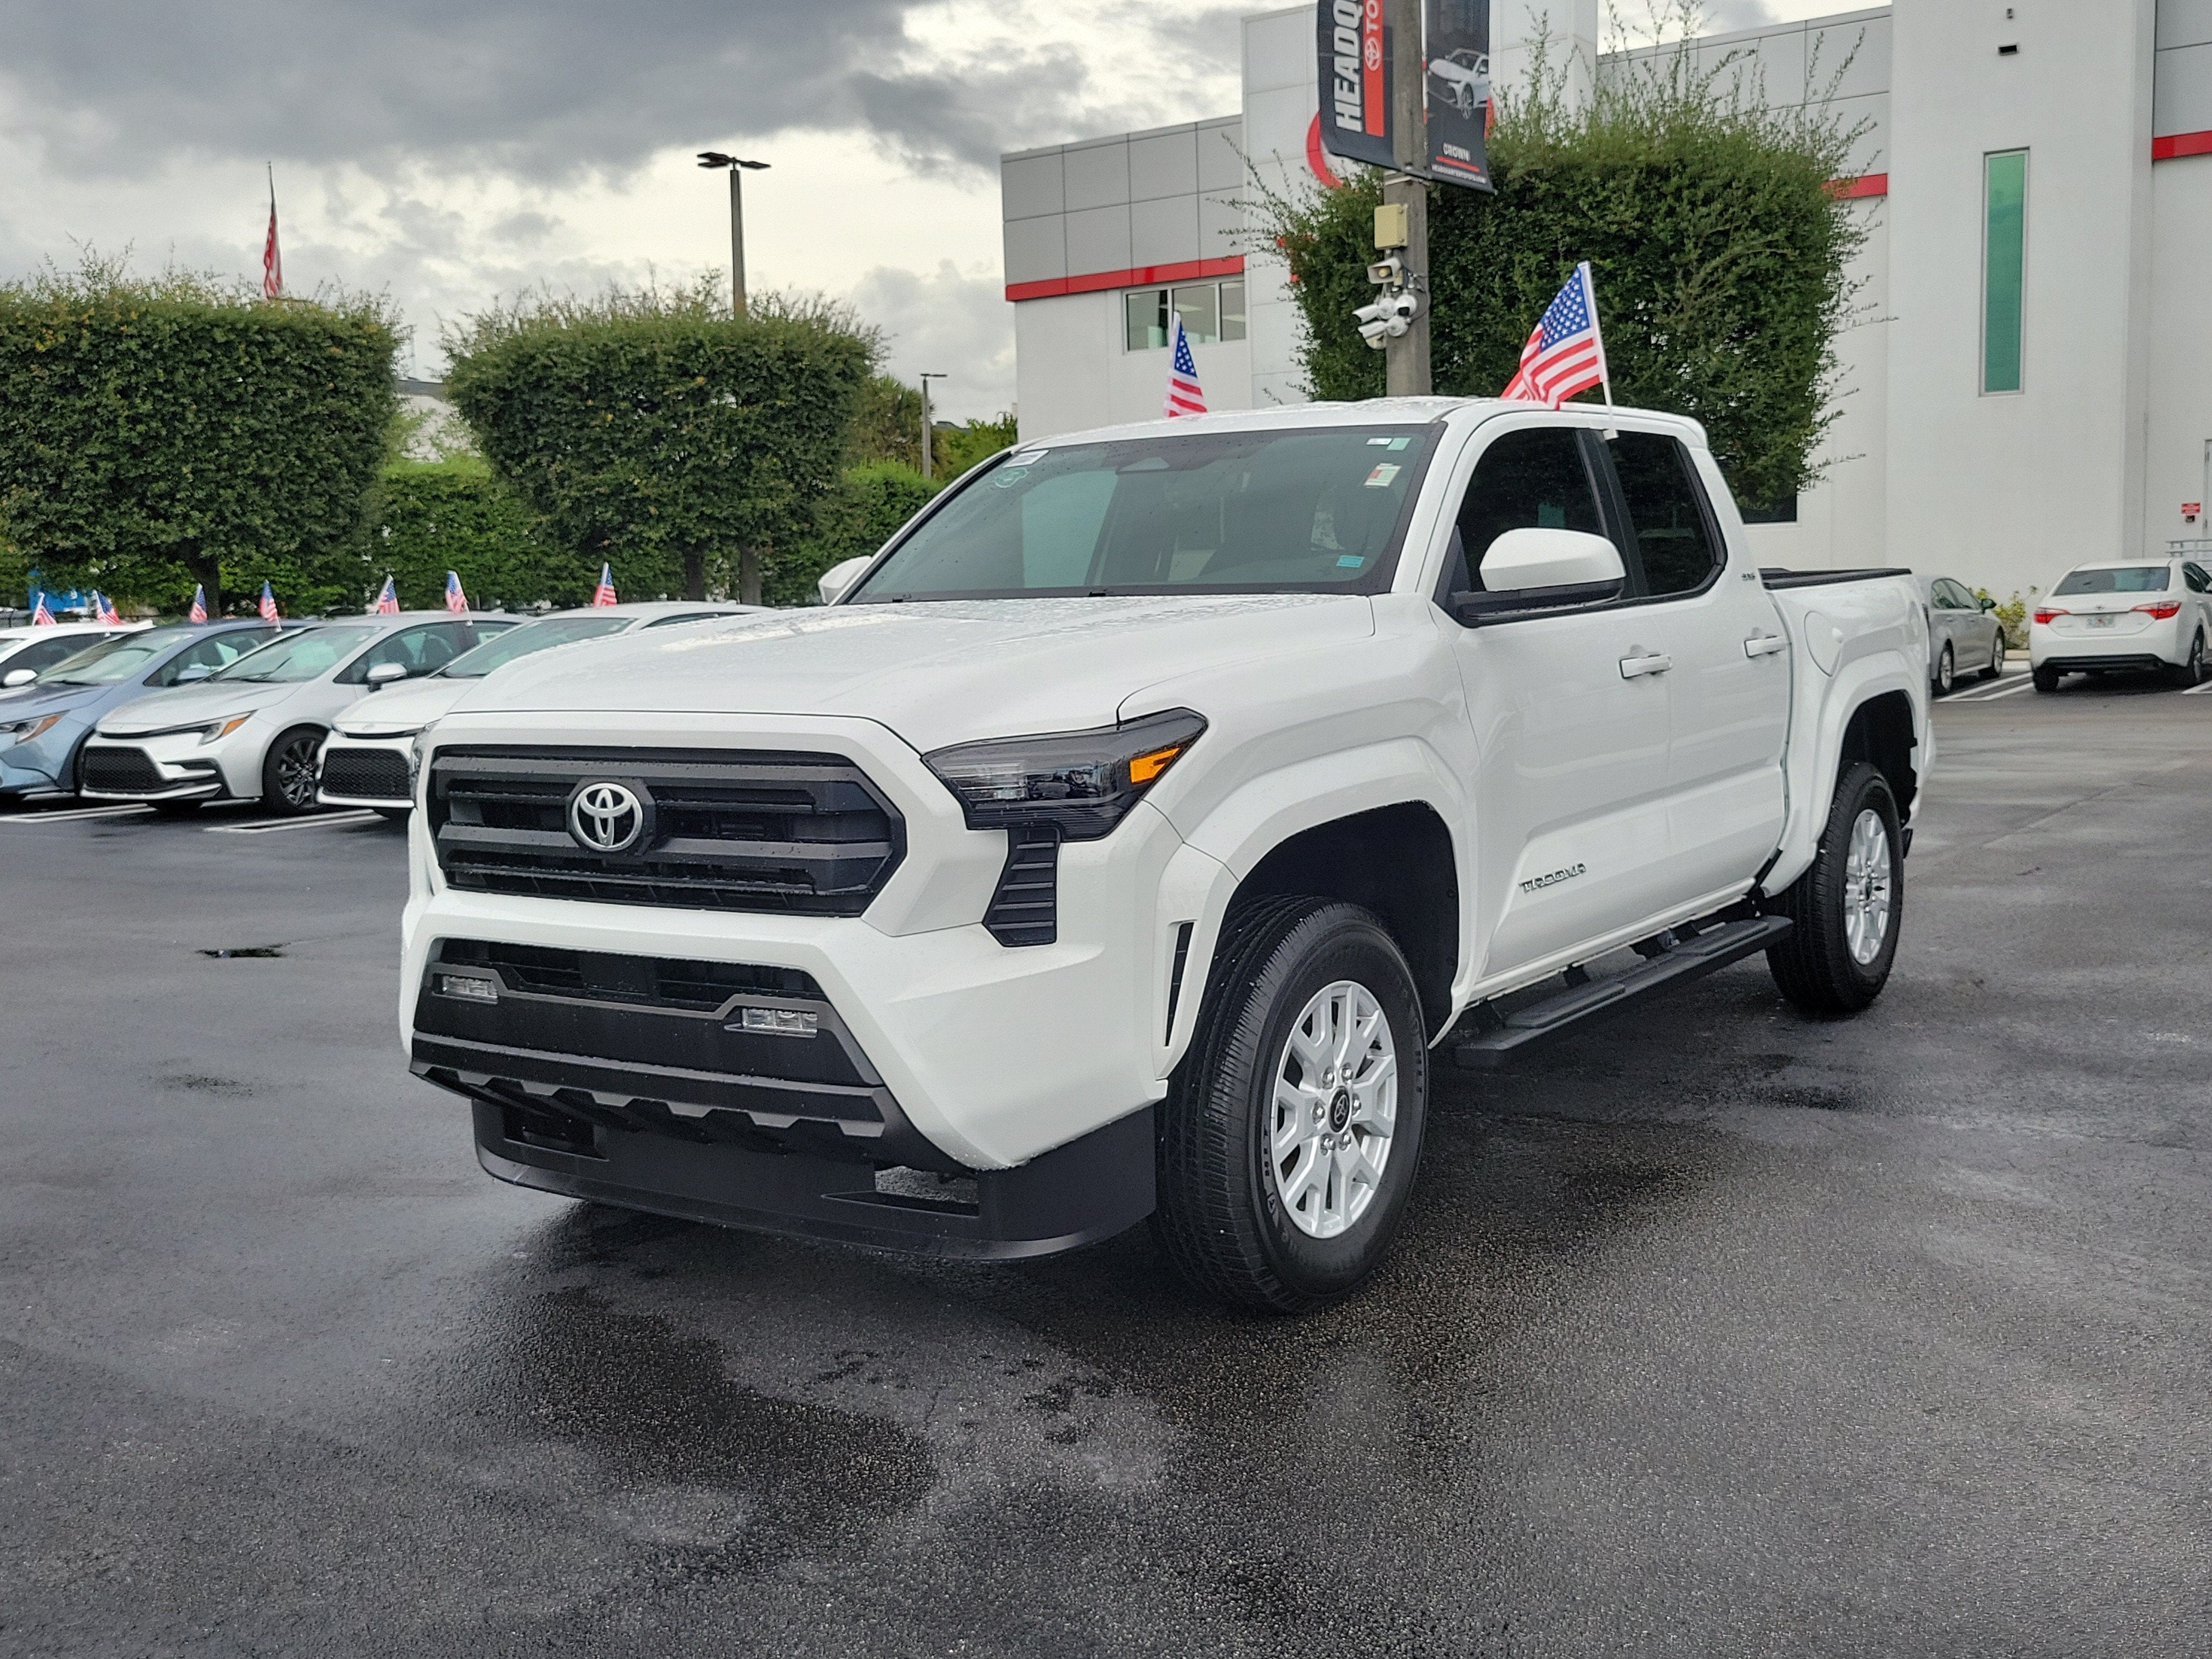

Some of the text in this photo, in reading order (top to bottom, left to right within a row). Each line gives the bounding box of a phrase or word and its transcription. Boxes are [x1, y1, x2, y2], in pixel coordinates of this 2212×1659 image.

[1333, 0, 1363, 132] HEADQ
[1443, 142, 1471, 162] CROWN
[1519, 863, 1586, 893] TACOMA
